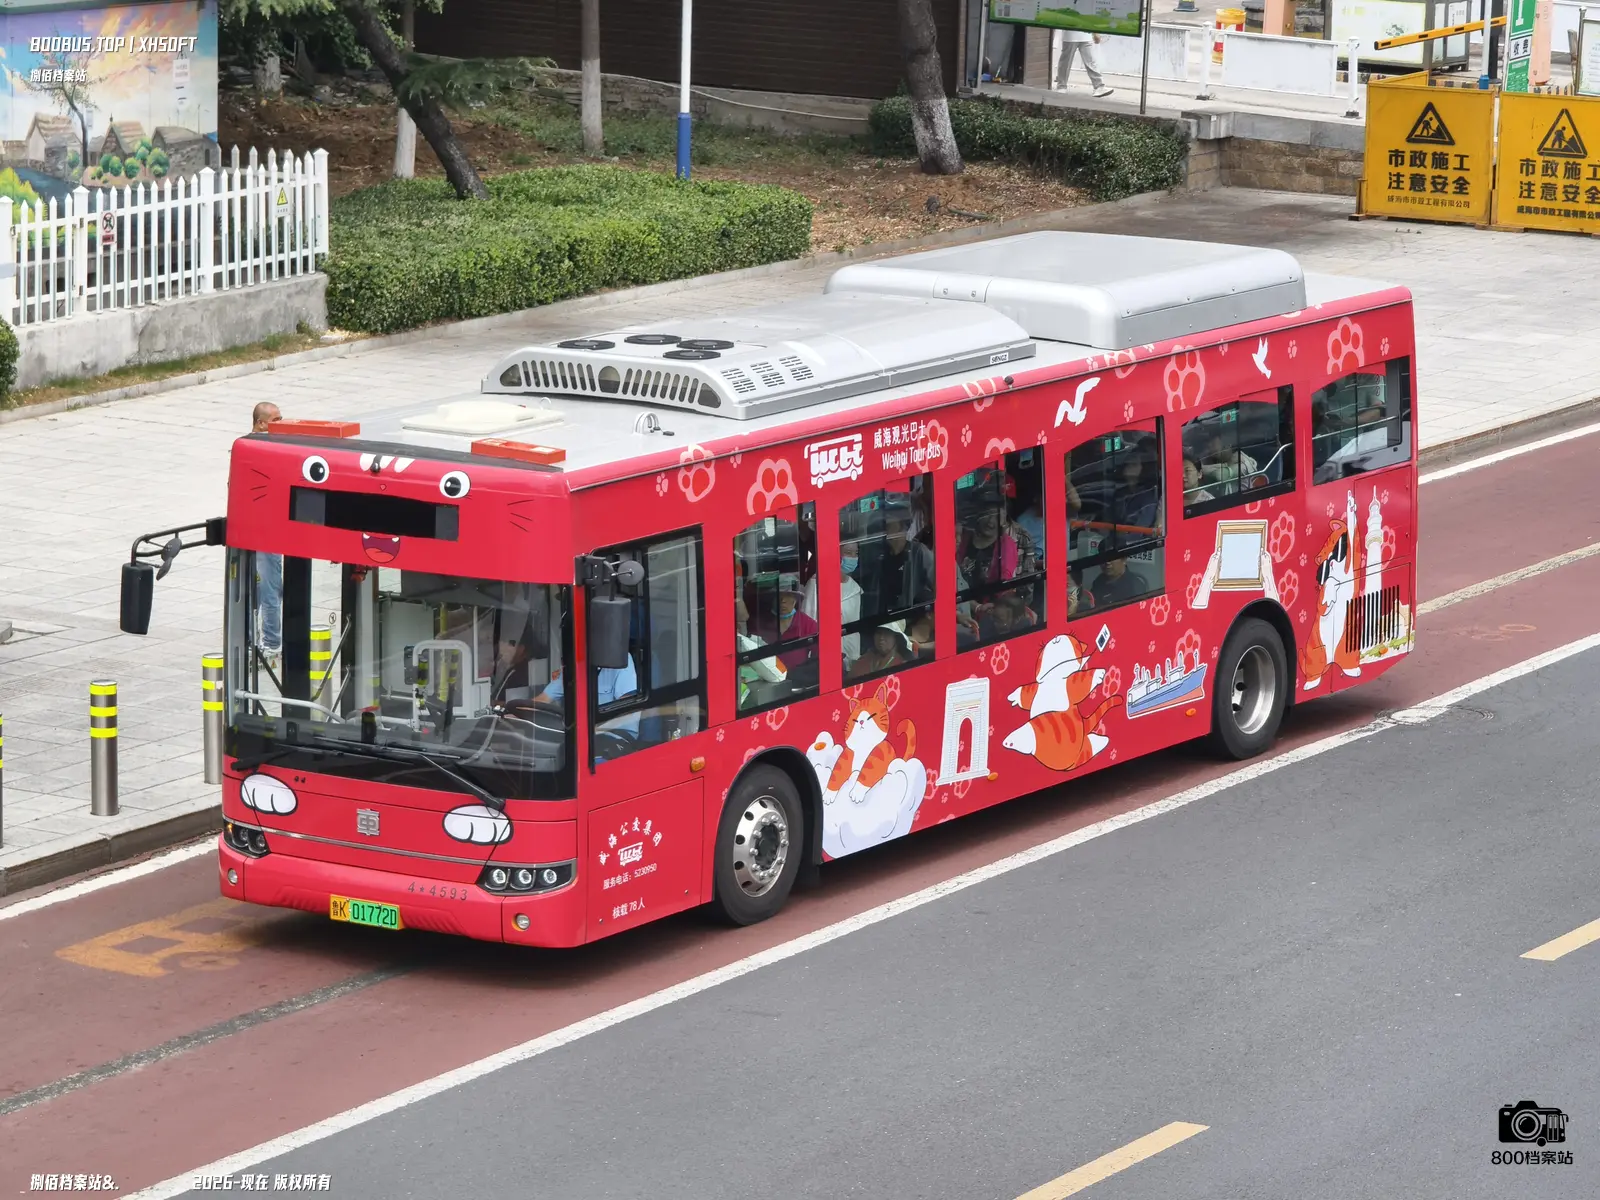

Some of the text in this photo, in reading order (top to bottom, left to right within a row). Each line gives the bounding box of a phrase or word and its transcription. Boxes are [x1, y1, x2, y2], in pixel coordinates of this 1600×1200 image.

[1388, 148, 1471, 172] 市政施工
[1519, 157, 1600, 181] 市政施工
[1387, 171, 1471, 196] 注意安全
[1518, 180, 1600, 205] 注意安全
[873, 419, 926, 449] 威海观光巴士
[881, 442, 941, 470] Weihai Tour Bus
